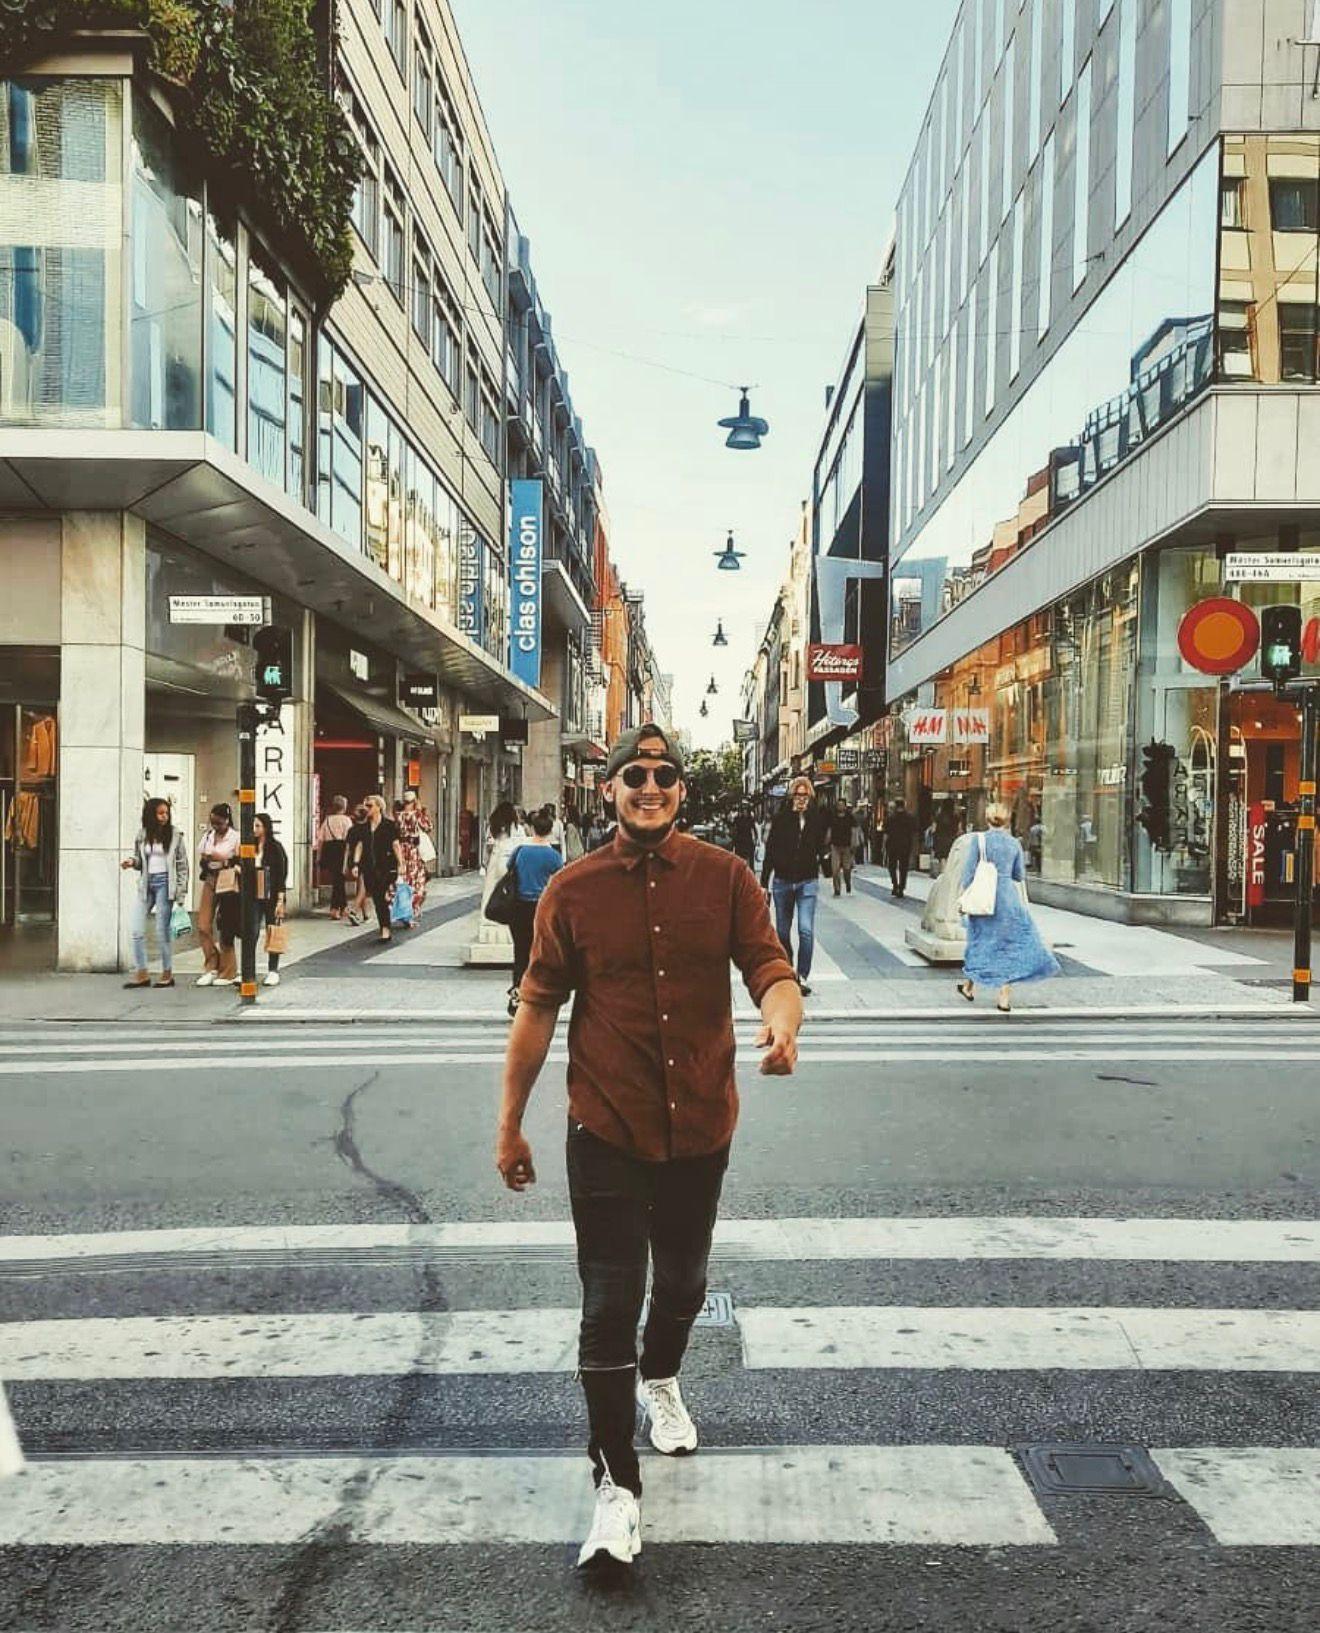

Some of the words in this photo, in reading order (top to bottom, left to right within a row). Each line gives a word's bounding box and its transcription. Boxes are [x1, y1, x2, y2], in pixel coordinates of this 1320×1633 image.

[514, 516, 537, 596] ohlson
[514, 601, 537, 651] clas
[1252, 824, 1266, 886] SALE
